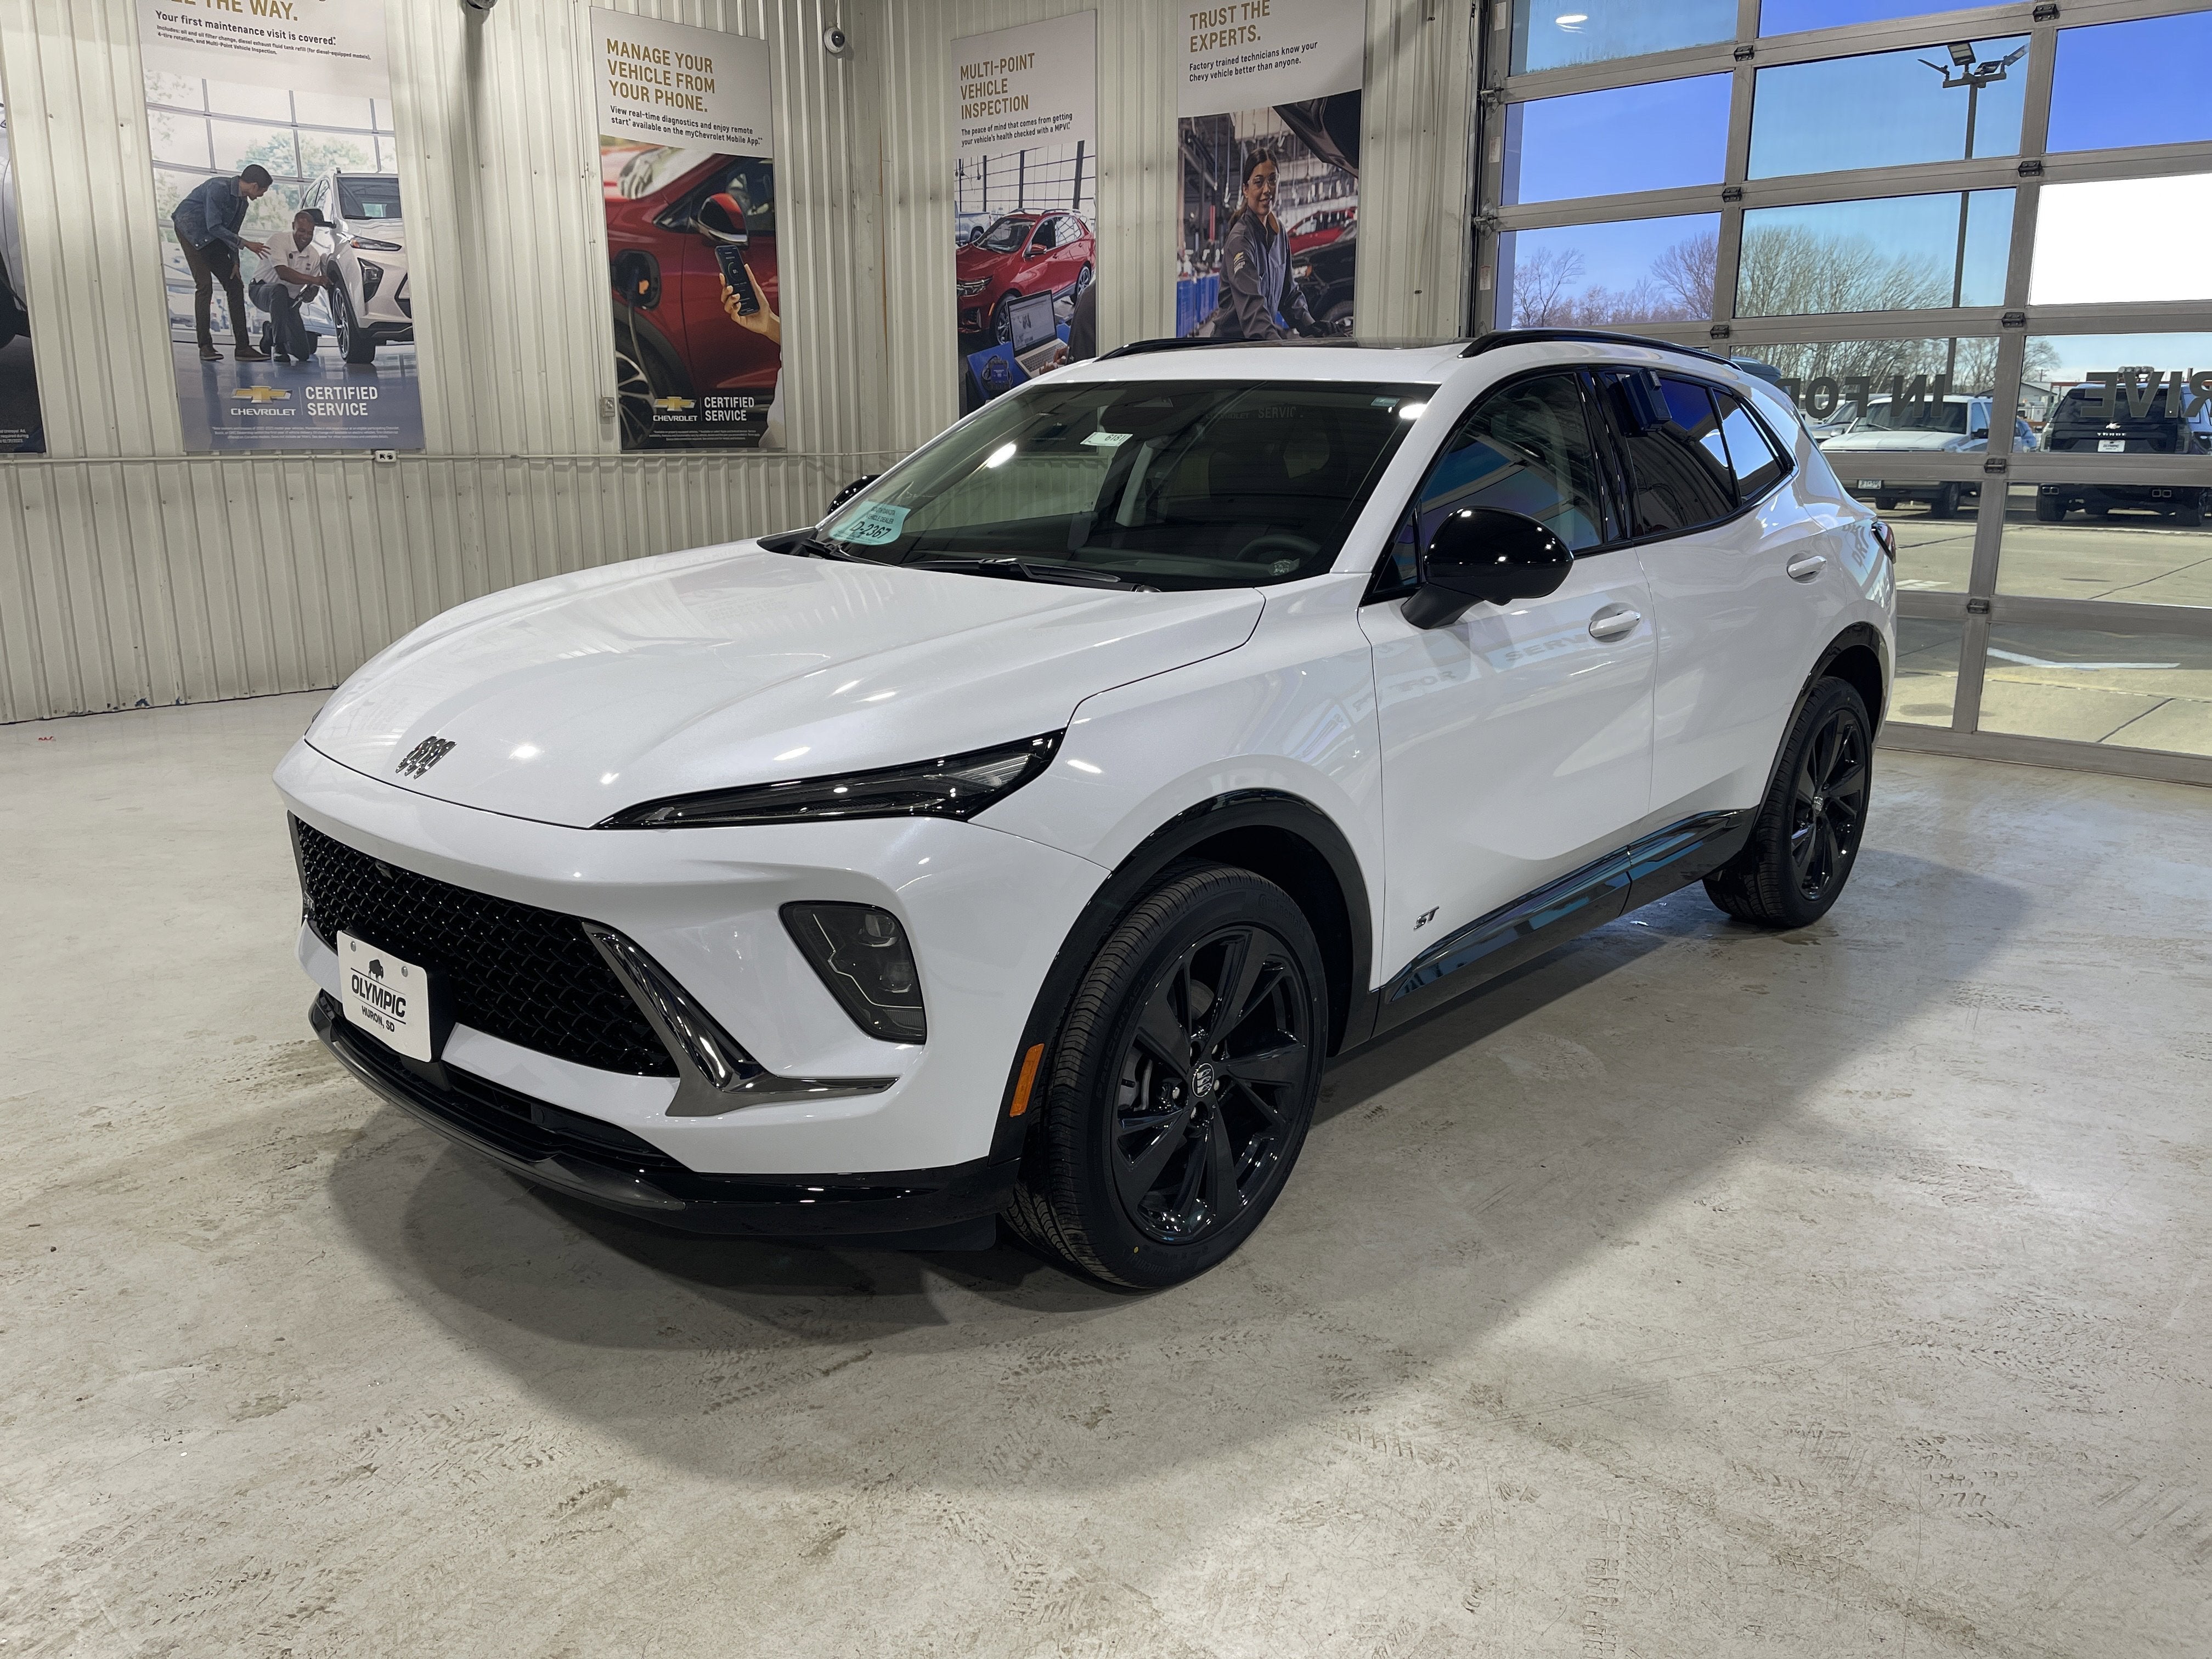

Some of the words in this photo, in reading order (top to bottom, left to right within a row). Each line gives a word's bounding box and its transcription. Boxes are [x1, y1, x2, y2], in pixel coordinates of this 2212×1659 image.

[250, 0, 298, 21] WAY.
[1190, 5, 1237, 31] TRUST
[1242, 0, 1270, 20] THE
[155, 10, 178, 22] Your
[181, 15, 203, 26] first
[205, 21, 264, 36] maintenance
[267, 29, 286, 39] visit
[289, 31, 296, 41] is
[157, 25, 180, 33] Includes:
[174, 33, 195, 43] rotation,
[206, 40, 233, 49] Multi-Point
[251, 47, 278, 55] Inspection.
[1190, 24, 1261, 53] EXPERTS.
[606, 38, 671, 66] MANAGE
[674, 52, 713, 74] YOUR
[960, 52, 1035, 81] MULTI-POINT
[1189, 61, 1214, 71] Factory
[1216, 55, 1239, 67] trained
[1241, 49, 1279, 63] technicians
[1281, 45, 1300, 55] know
[1301, 42, 1318, 54] your
[607, 59, 672, 87] VEHICLE
[676, 72, 715, 94] FROM
[1189, 72, 1209, 82] Chevy
[1210, 68, 1233, 80] vehicle
[1234, 64, 1256, 75] better
[1257, 61, 1273, 71] than
[1274, 58, 1301, 69] anyone.
[608, 80, 650, 103] YOUR
[655, 88, 708, 112] PHONE.
[960, 78, 1008, 100] VEHICLE
[961, 94, 1029, 120] INSPECTION
[610, 105, 627, 116] View
[628, 109, 660, 122] real-time
[662, 115, 699, 128] diagnostics
[700, 120, 712, 130] and
[713, 123, 730, 133] enjoy
[731, 126, 753, 135] remote
[632, 120, 662, 132] available
[672, 126, 684, 136] the
[685, 129, 725, 141] myChevrolet
[726, 134, 746, 143] Mobile
[972, 127, 986, 136] peace
[994, 122, 1007, 131] mind
[1008, 121, 1019, 129] that
[1038, 116, 1052, 125] from
[1052, 112, 1073, 124] getting
[961, 138, 973, 148] your
[974, 134, 995, 144] vehicle's
[996, 131, 1013, 140] health
[1014, 128, 1035, 138] checked
[1037, 126, 1049, 134] with
[305, 386, 378, 400] CERTIFIED
[704, 397, 754, 408] CERTIFIED
[230, 408, 296, 416] CHEVROLET
[307, 403, 368, 416] SERVICE
[705, 410, 747, 421] SERVICE
[850, 521, 892, 539] D-2367
[351, 974, 407, 1018] OLYMPIC
[362, 1005, 384, 1029] HURON,
[386, 1019, 394, 1032] SD
